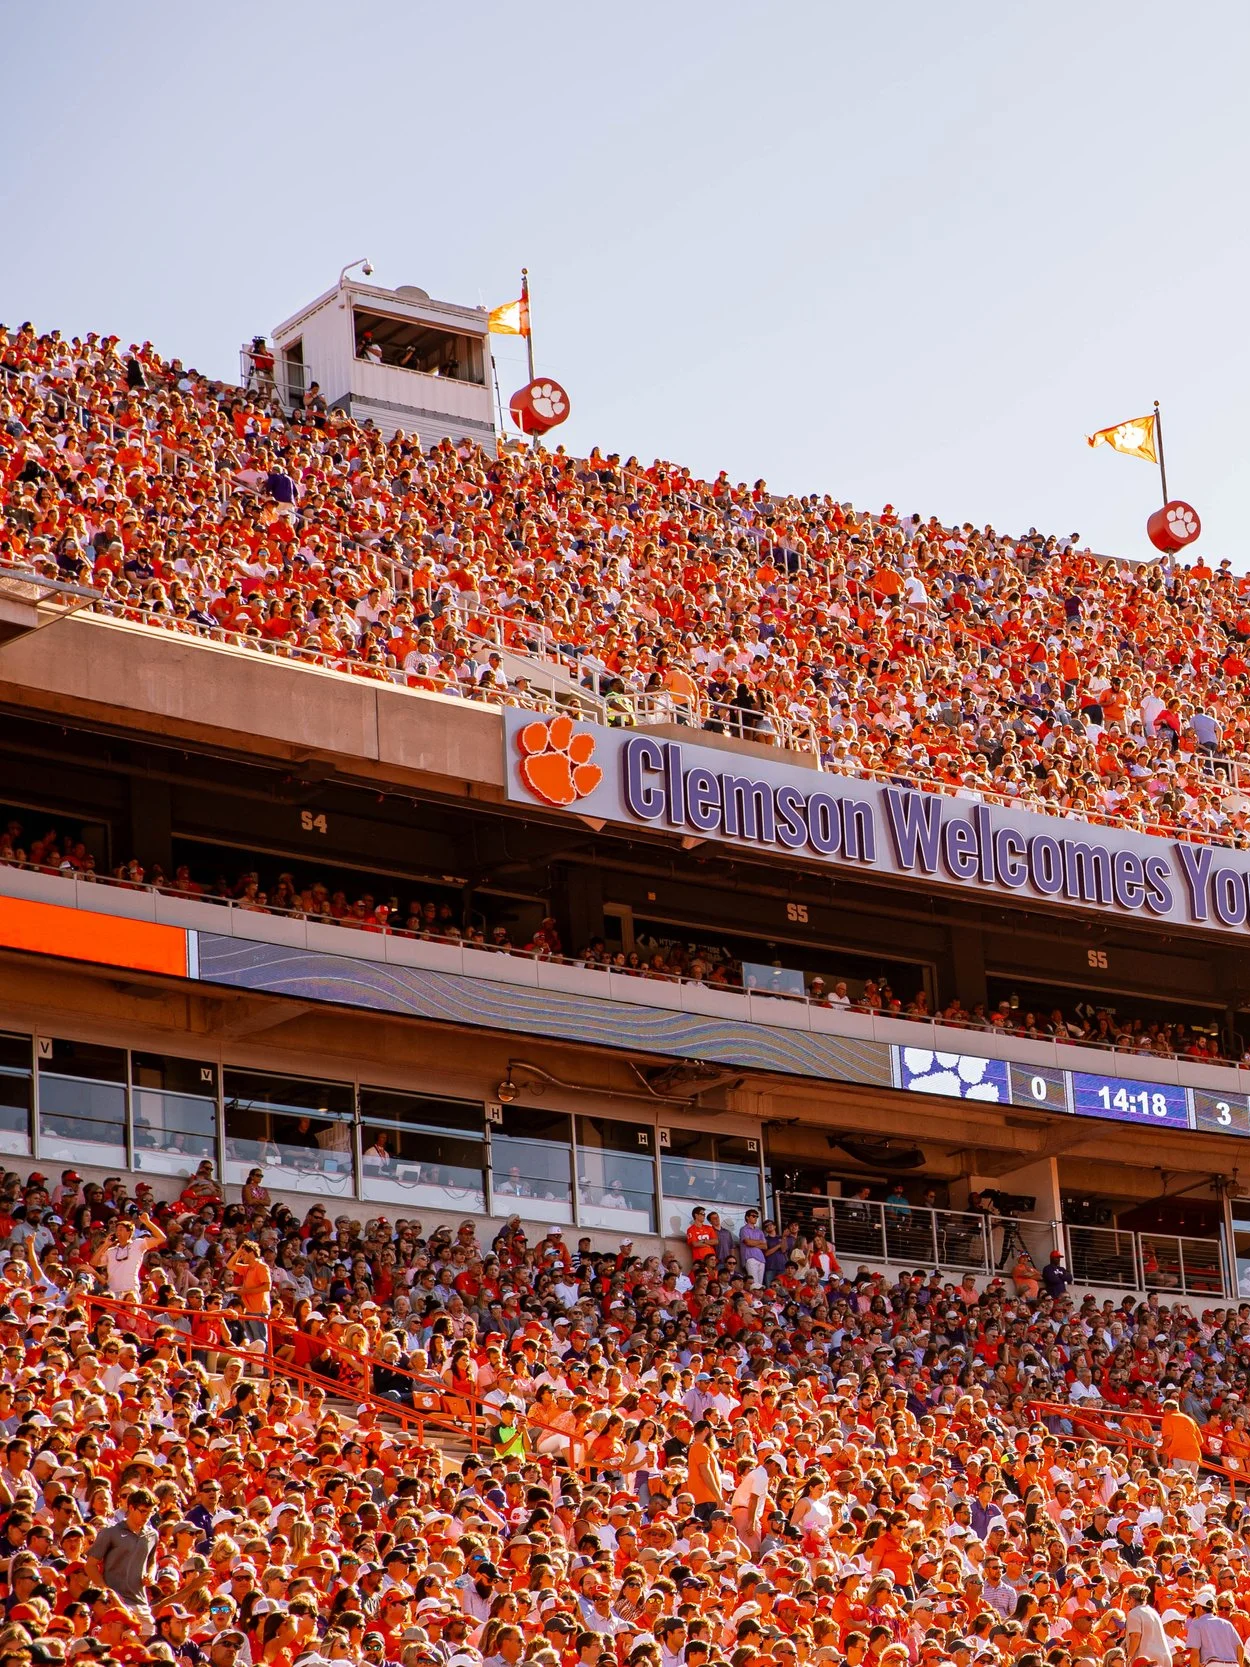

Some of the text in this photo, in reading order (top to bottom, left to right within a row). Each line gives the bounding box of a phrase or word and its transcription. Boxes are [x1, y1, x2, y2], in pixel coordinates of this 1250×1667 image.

[301, 810, 327, 834] S4
[624, 735, 878, 863] Clemson
[884, 787, 1173, 915] Welcomes
[786, 903, 808, 923] S5
[1087, 949, 1108, 969] S5
[40, 1041, 50, 1055] V
[203, 1070, 211, 1080] V
[1031, 1077, 1048, 1101] 0
[1097, 1084, 1167, 1118] 14:18
[491, 1107, 500, 1119] H
[1216, 1103, 1232, 1126] 3
[639, 1133, 647, 1143] H
[660, 1131, 668, 1143] R
[748, 1141, 755, 1151] R
